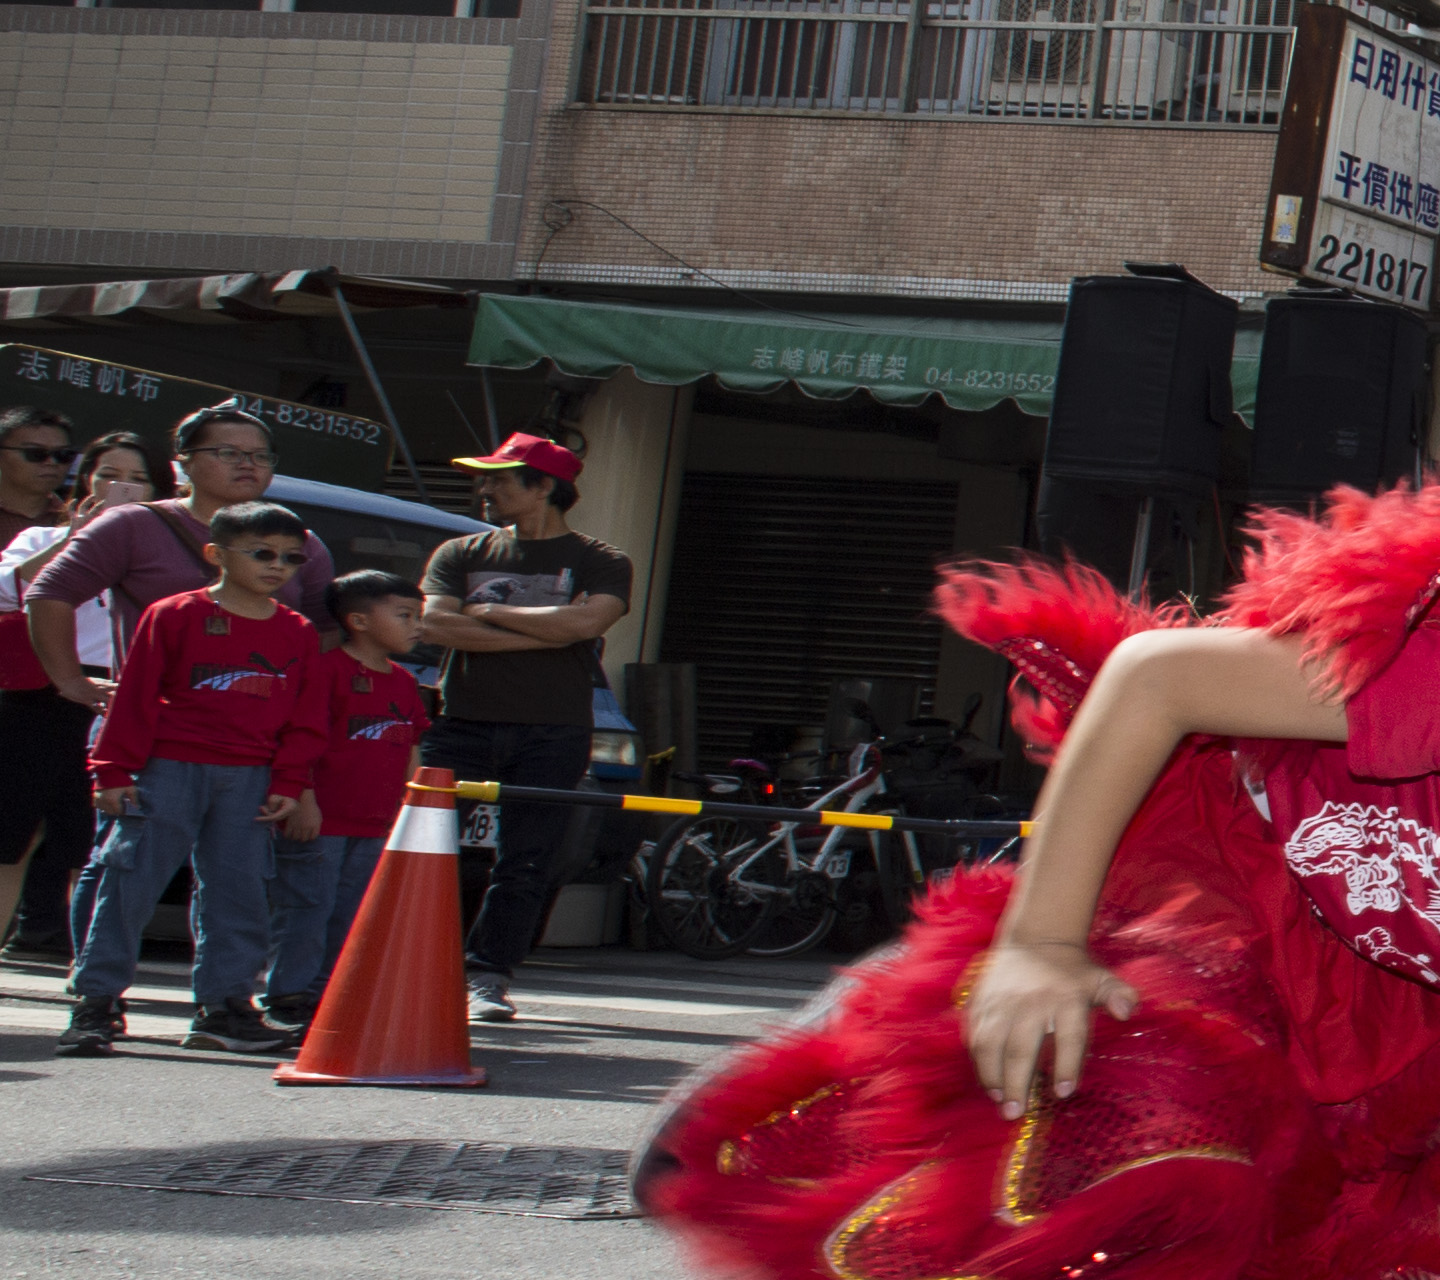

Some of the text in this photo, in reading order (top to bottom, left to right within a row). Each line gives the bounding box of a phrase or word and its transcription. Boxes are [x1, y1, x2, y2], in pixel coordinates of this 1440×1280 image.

[1334, 150, 1440, 229] 平價供應
[1315, 234, 1428, 302] 221817
[16, 350, 162, 402] 志峰帆布
[751, 346, 1056, 395] 志峰帆布鐵架 04-8231552
